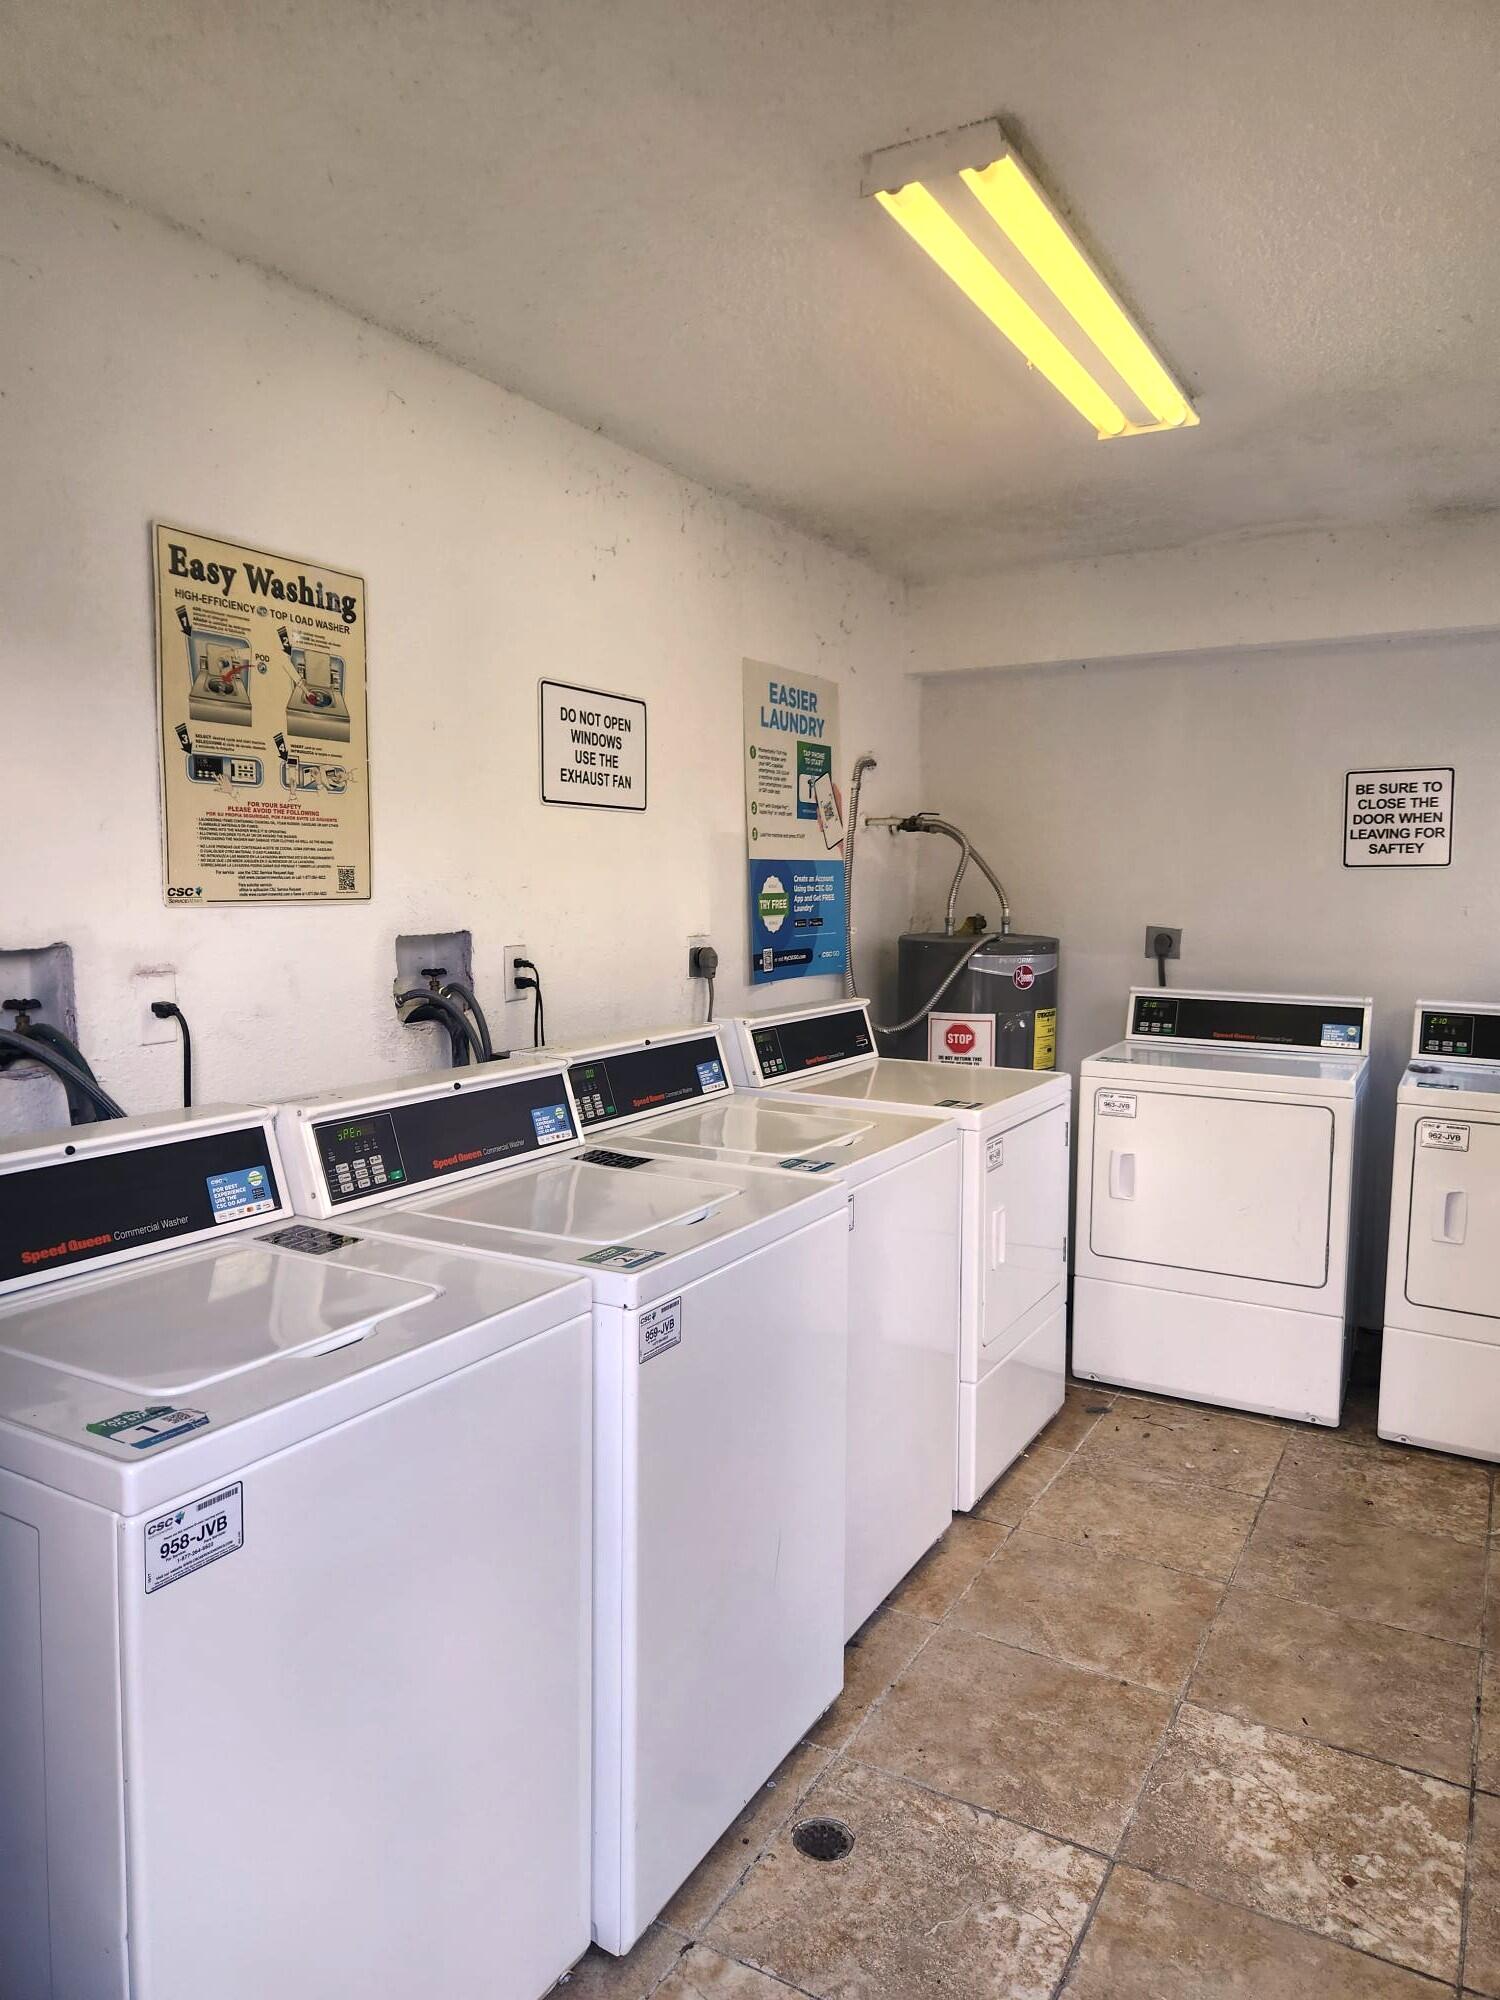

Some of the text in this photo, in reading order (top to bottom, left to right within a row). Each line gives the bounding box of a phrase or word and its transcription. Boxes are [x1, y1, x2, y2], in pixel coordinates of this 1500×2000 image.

[168, 543, 357, 624] Easy Washing
[174, 588, 350, 634] HIGH-EFFICIENCY TOP LOAD WASHER
[282, 636, 290, 646] 2
[255, 653, 270, 662] POD
[769, 682, 818, 713] EASIER
[560, 706, 631, 732] DO NOT OPEN
[761, 706, 824, 738] LAUNDRY
[182, 734, 188, 744] 3
[571, 729, 622, 750] WINDOWS
[575, 750, 618, 768] USE THE
[560, 768, 631, 789] EXHAUST FAN
[1356, 781, 1443, 795] BE SURE TO
[1358, 797, 1439, 810] CLOSE THE
[1353, 812, 1443, 825] DOOR WHEN
[1350, 827, 1445, 840] LEAVING FOR
[1369, 843, 1424, 854] SAFTEY
[167, 888, 194, 896] CSC
[761, 899, 787, 909] TRY FREE
[947, 1034, 972, 1044] STOP
[1428, 1132, 1461, 1141] 962-JVB
[432, 1154, 458, 1169] Speed
[458, 1149, 483, 1161] Queen
[482, 1144, 509, 1156] Commercial
[214, 1186, 246, 1199] EXPERIENCE
[21, 1215, 189, 1263] Speed Queen Commercial Washer
[640, 1314, 652, 1324] CSC
[645, 1319, 674, 1342] 959-JVB
[148, 1518, 174, 1535] CSC
[160, 1516, 227, 1559] 958-JVB
